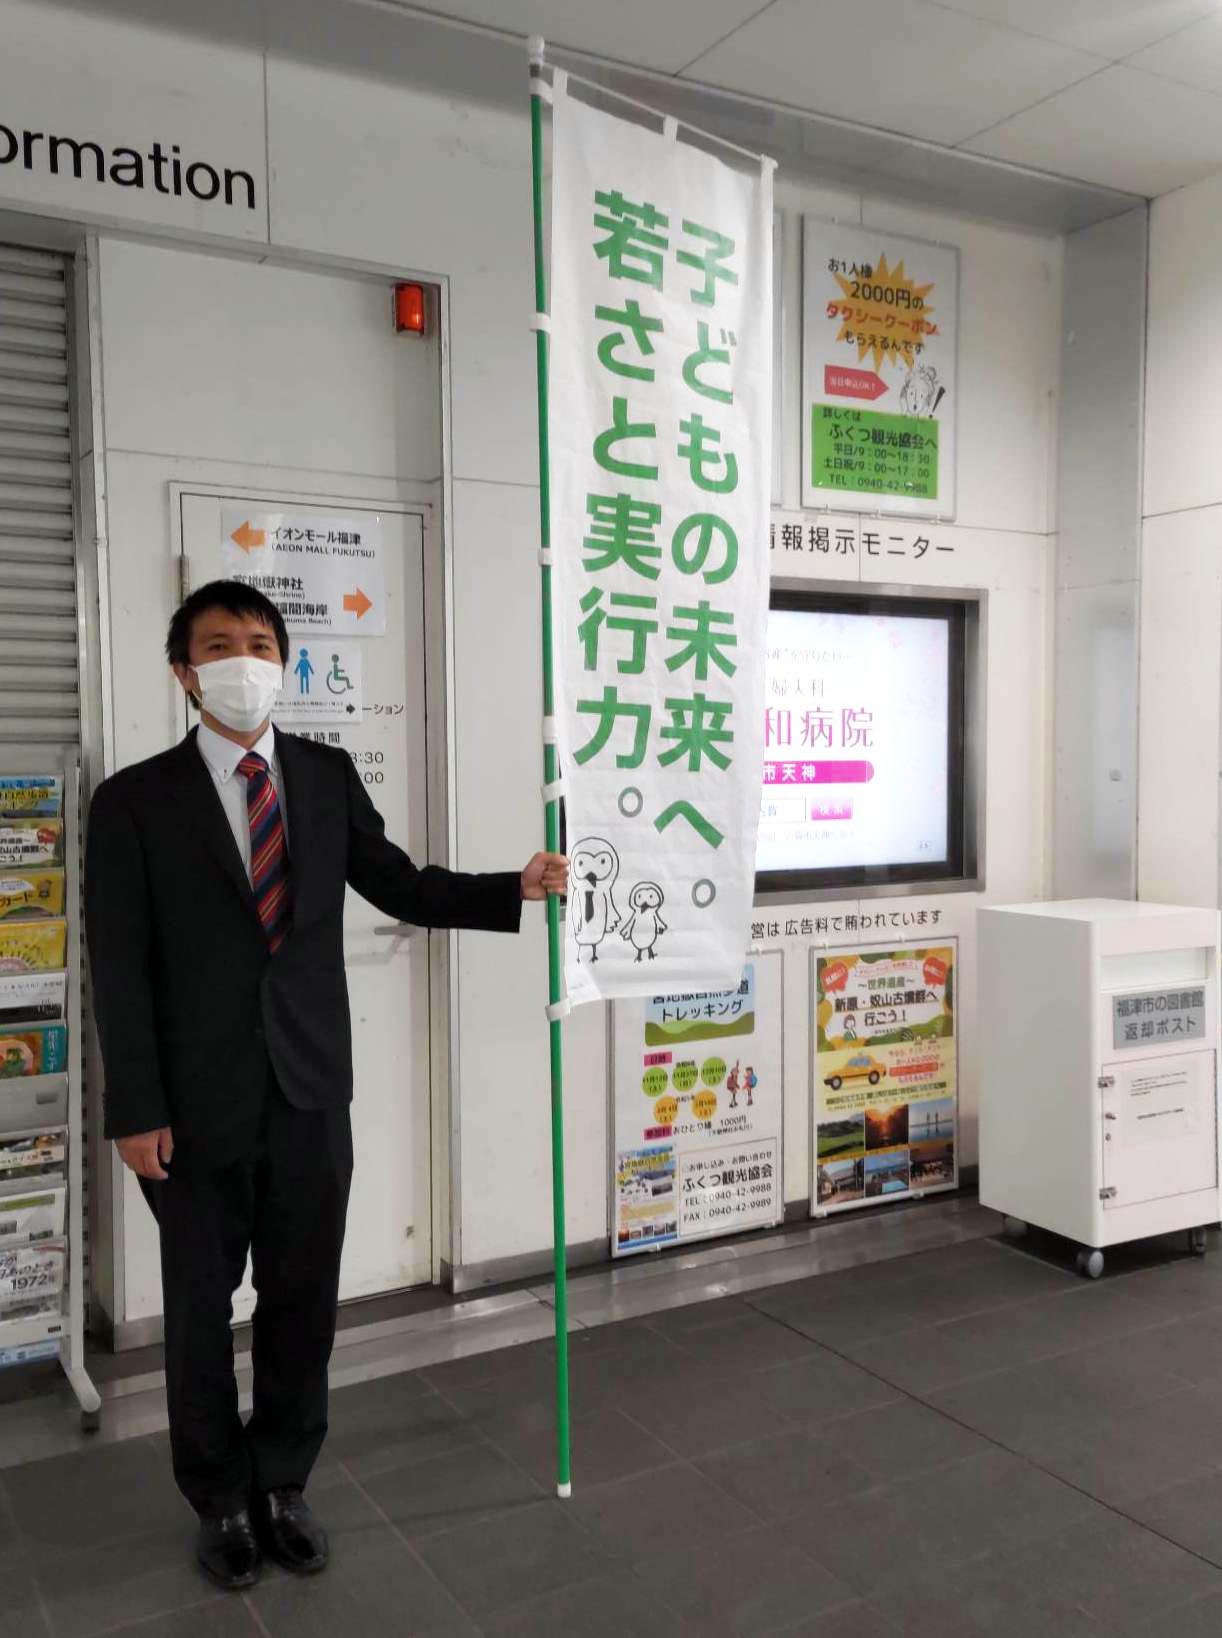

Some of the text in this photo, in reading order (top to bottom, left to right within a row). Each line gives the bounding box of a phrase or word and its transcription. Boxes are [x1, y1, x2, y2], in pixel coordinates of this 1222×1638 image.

[850, 280, 924, 311] 2000円の
[829, 422, 938, 450] ふくつ観光協会へ
[272, 526, 361, 546] イオンモール福津
[306, 545, 330, 555] MALL
[333, 547, 376, 559] FUKUTSU)
[652, 217, 740, 908] 子どもの未来へ。
[764, 706, 874, 749] 和病院
[662, 1000, 744, 1024] トレッキング
[1117, 991, 1204, 1017] 福津市の図書館
[864, 1008, 907, 1028] 行こう！
[1124, 1016, 1196, 1041] 返却ポスト
[682, 1162, 774, 1193] ふくつ観光協会
